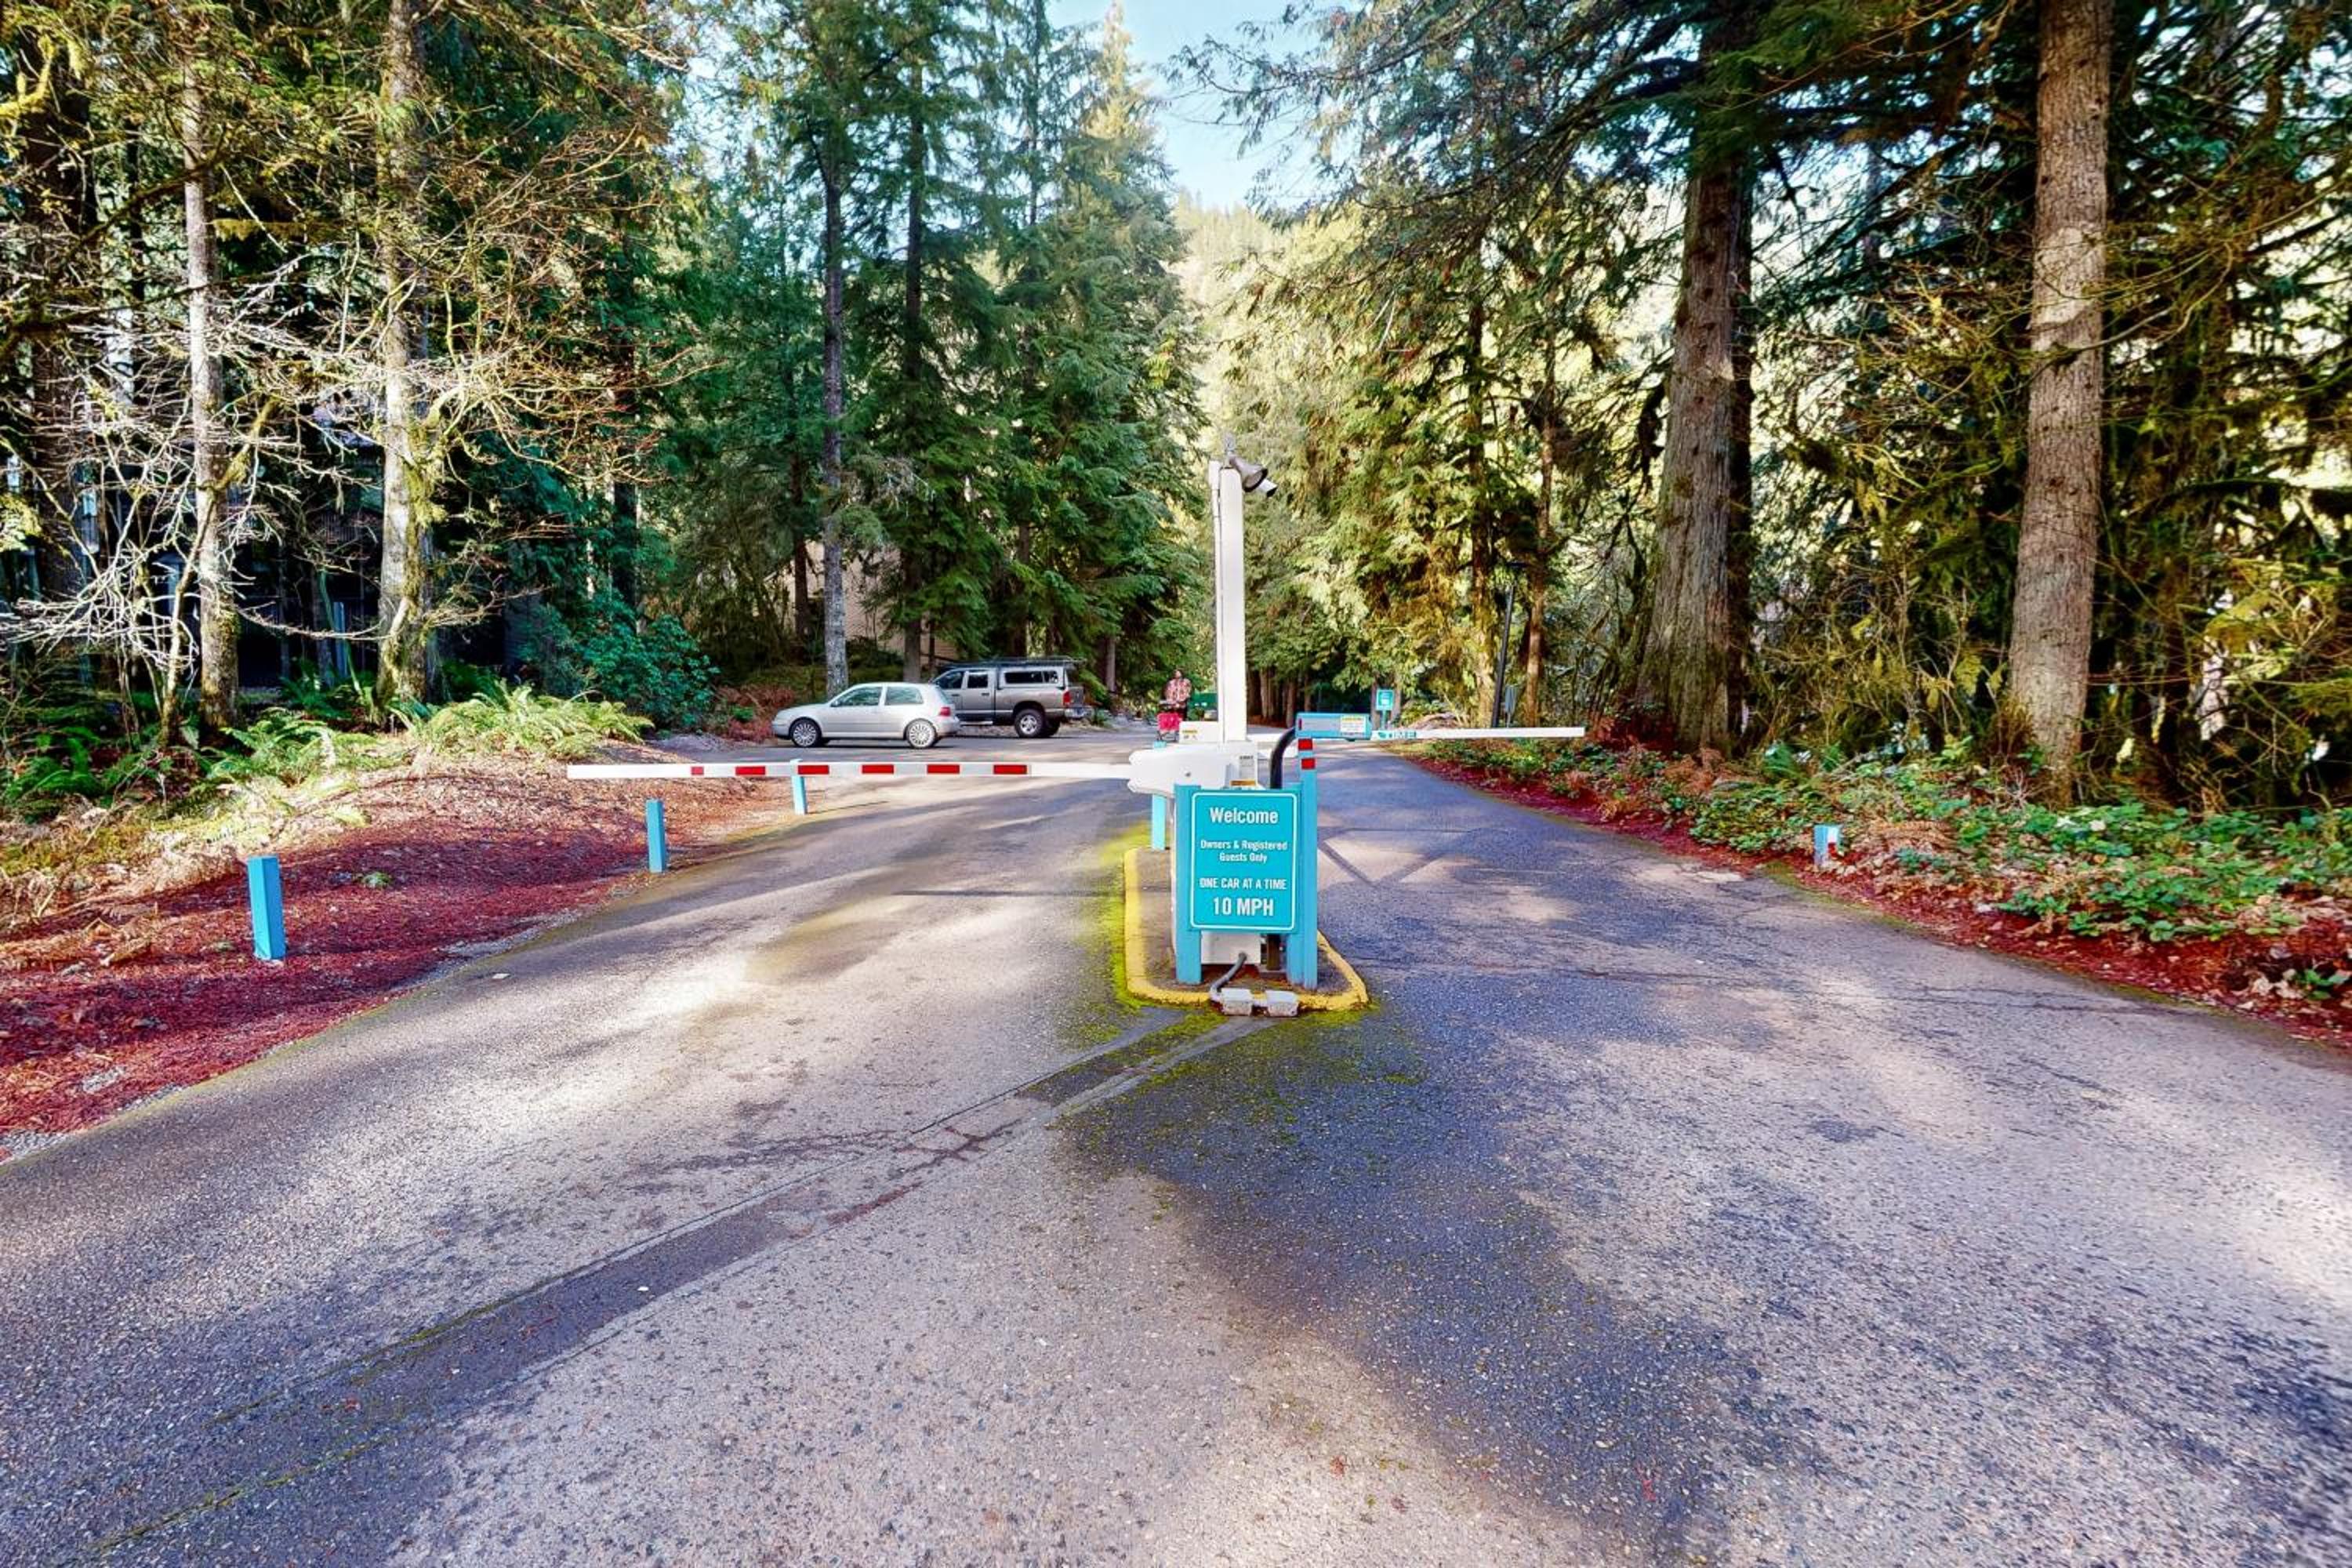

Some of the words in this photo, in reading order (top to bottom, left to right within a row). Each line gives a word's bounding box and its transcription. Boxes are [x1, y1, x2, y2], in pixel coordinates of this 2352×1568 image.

[1210, 807, 1279, 824] Welcome
[1200, 840, 1231, 849] Owners
[1233, 840, 1240, 849] &
[1242, 840, 1288, 851] Registered
[1219, 852, 1247, 862] Guests
[1249, 852, 1267, 863] Only
[1200, 877, 1218, 888] ONE
[1221, 877, 1240, 888] CAR
[1243, 878, 1254, 889] AT
[1255, 878, 1262, 889] A
[1264, 879, 1287, 890] TIME
[1213, 896, 1232, 916] 10
[1236, 898, 1274, 916] MPH
